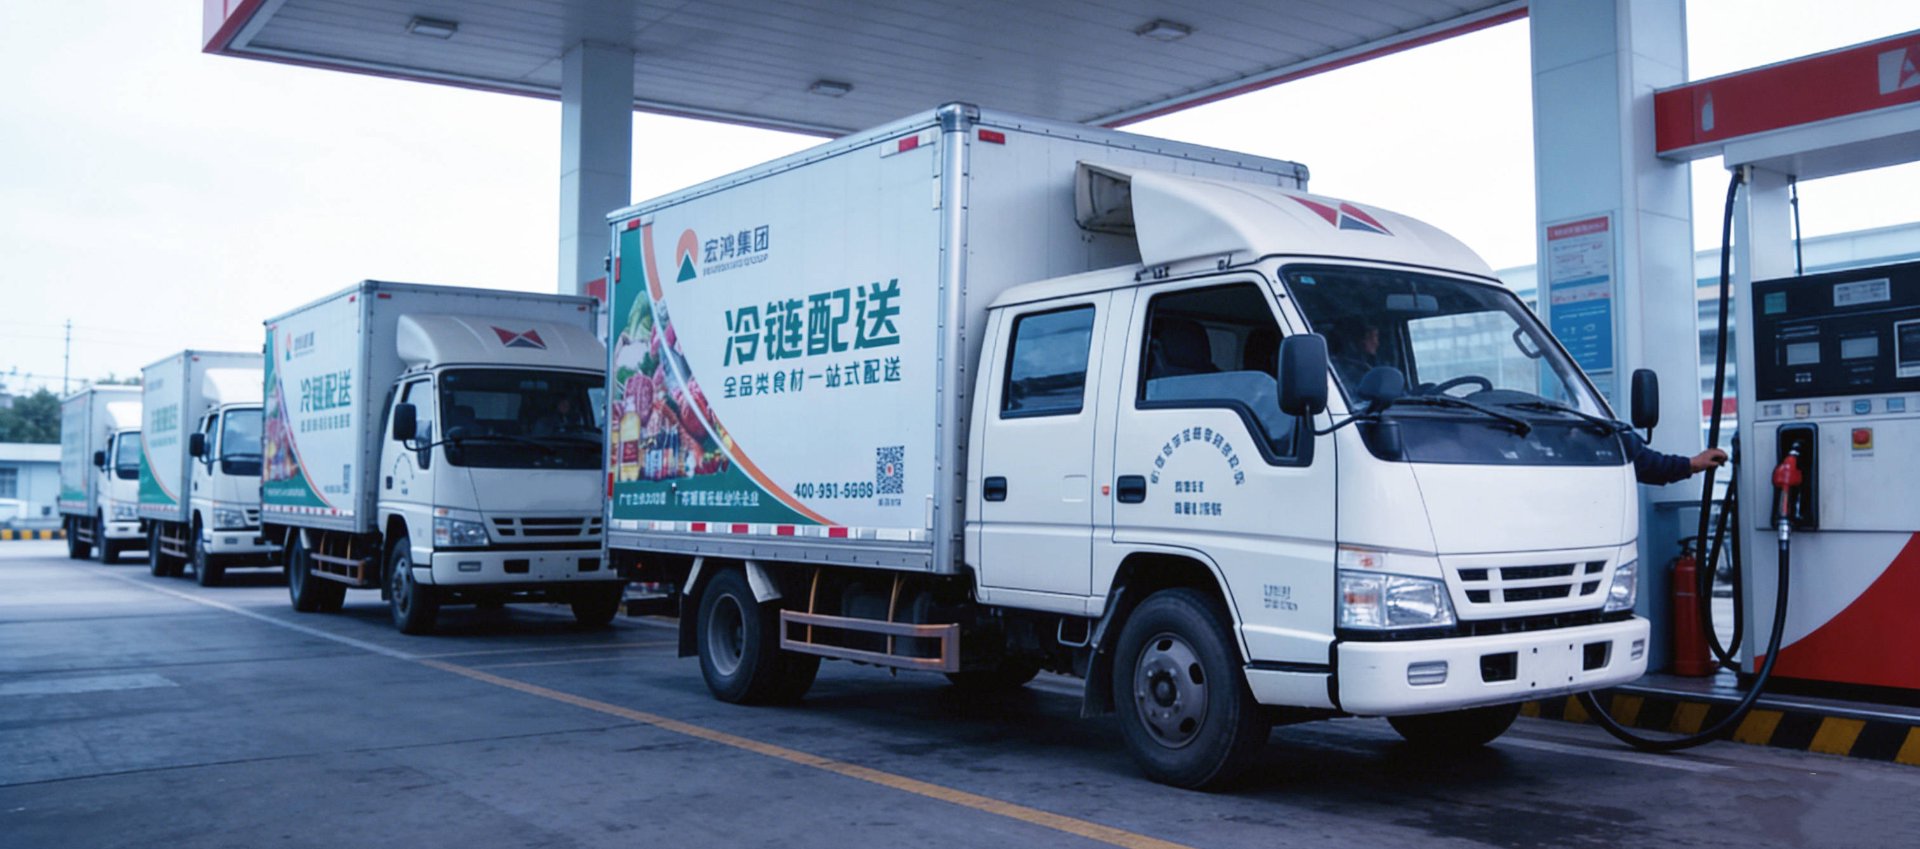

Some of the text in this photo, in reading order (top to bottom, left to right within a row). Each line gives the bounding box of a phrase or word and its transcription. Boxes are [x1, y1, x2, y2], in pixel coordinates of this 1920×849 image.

[704, 224, 769, 264] 宏鸿集团
[723, 278, 900, 367] 冷链配送
[723, 356, 902, 398] 全品类食材一站式配送
